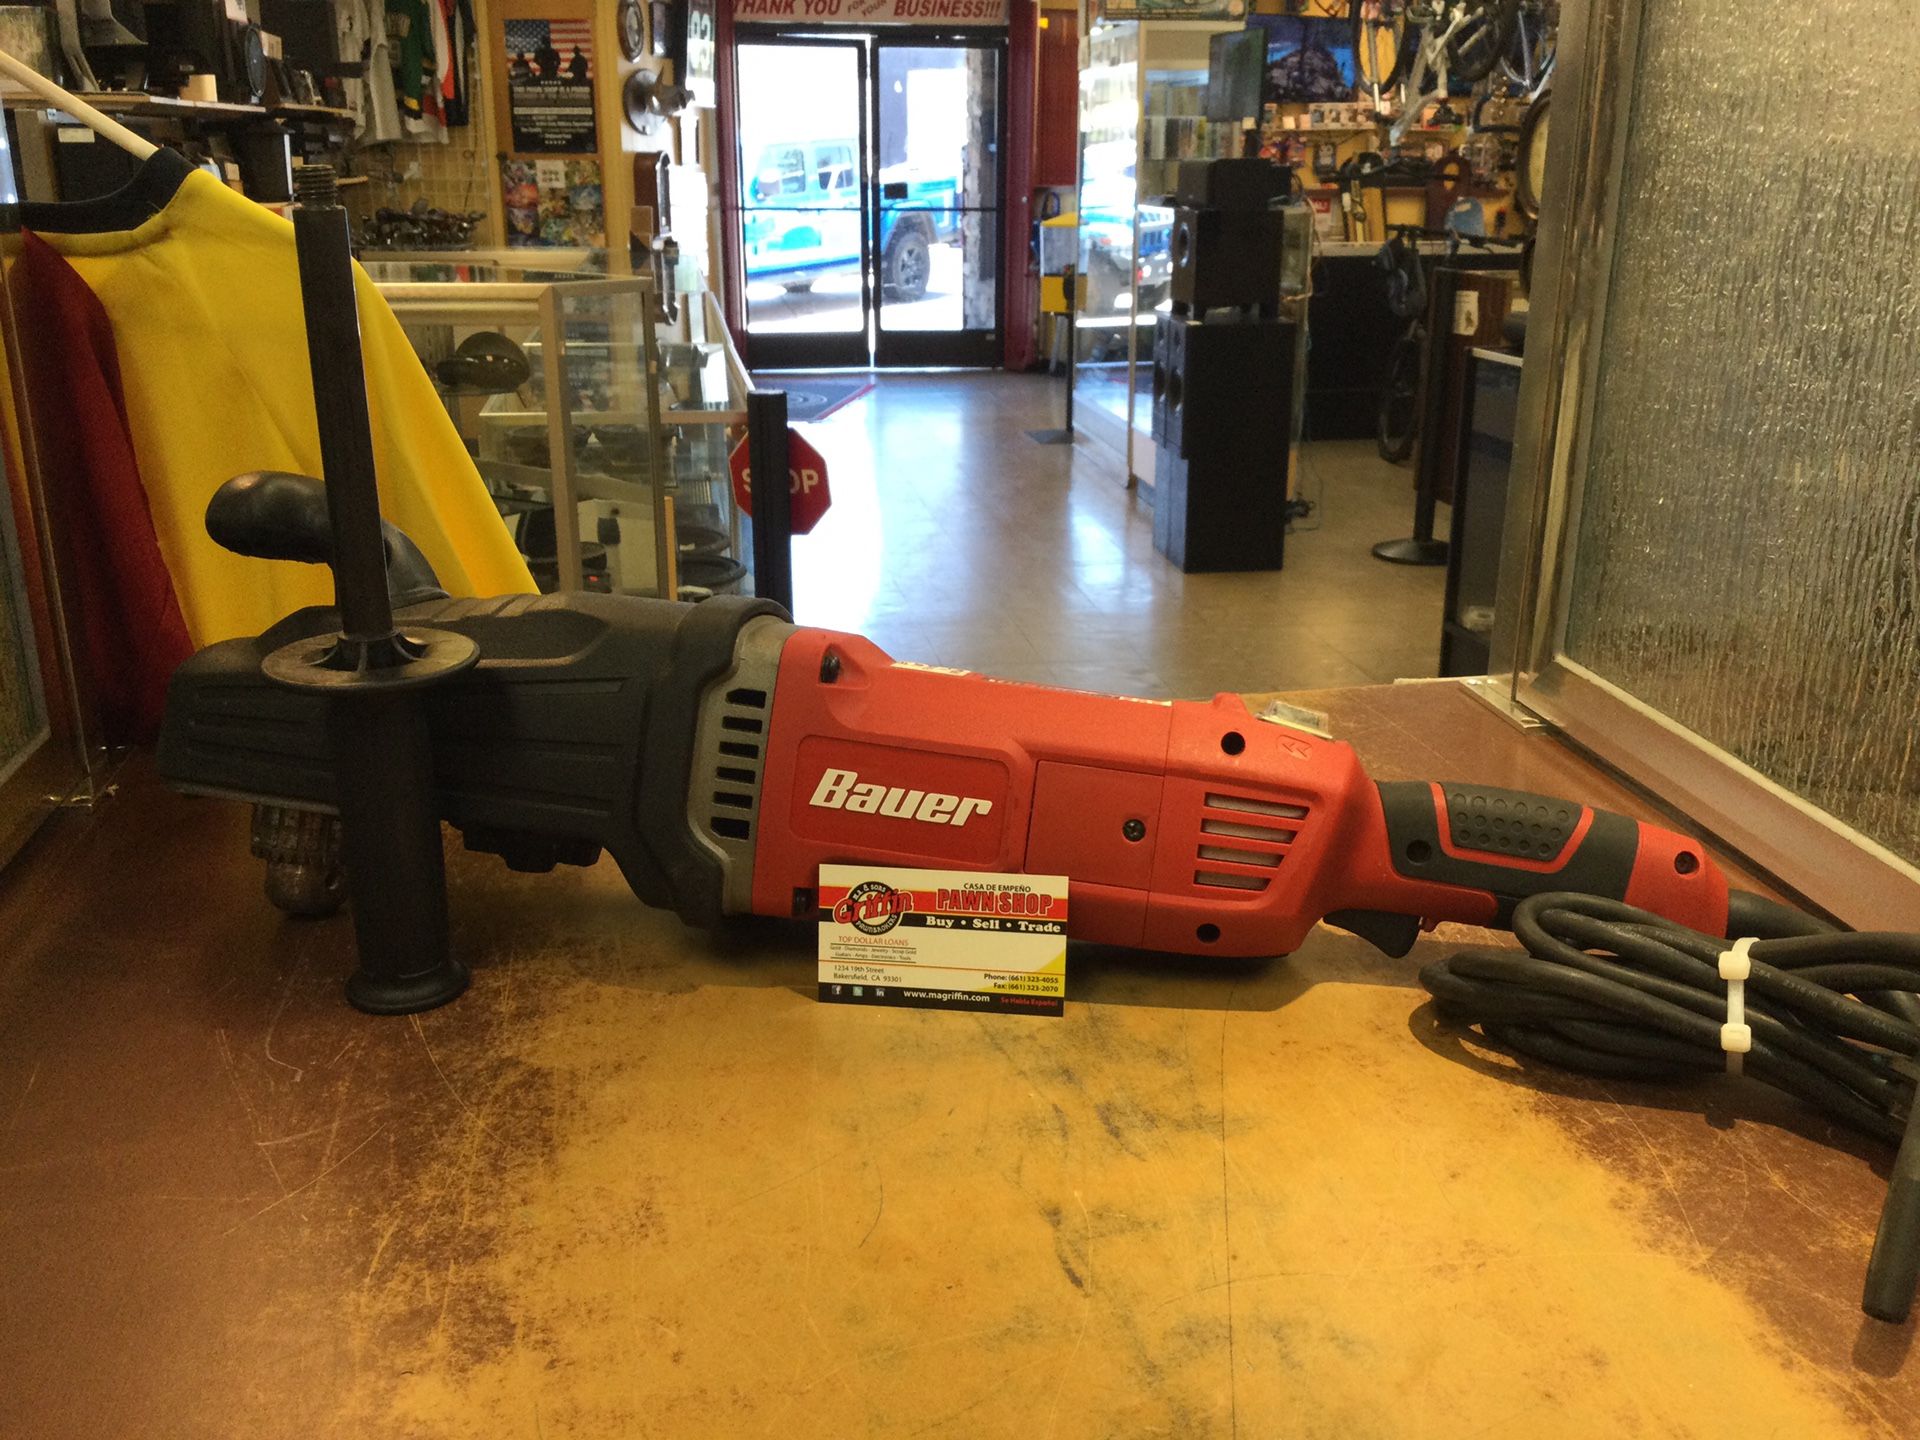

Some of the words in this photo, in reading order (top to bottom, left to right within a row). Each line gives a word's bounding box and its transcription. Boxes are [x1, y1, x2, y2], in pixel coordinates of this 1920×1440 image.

[733, 0, 795, 15] THANK
[804, 0, 840, 15] YOU
[893, 0, 1000, 18] BUSINESS!!!
[809, 768, 993, 827] Bauer
[963, 882, 985, 891] CASA
[998, 884, 1031, 893] EMPEÑO
[833, 888, 913, 925] Griffin
[936, 888, 995, 912] PAWN
[998, 891, 1053, 915] SHOP
[926, 916, 955, 928] Buy
[972, 918, 1000, 930] Sell
[1018, 921, 1061, 933] Trade
[854, 937, 883, 945] DOLLAR
[884, 938, 909, 946] LOANS
[984, 973, 1007, 981] Phone:
[1008, 974, 1026, 982] (661)
[1027, 975, 1059, 984] 323-4055
[1008, 983, 1026, 991] (661)
[1027, 984, 1059, 993] 323-2070
[903, 990, 990, 1003] www.magriffin.com
